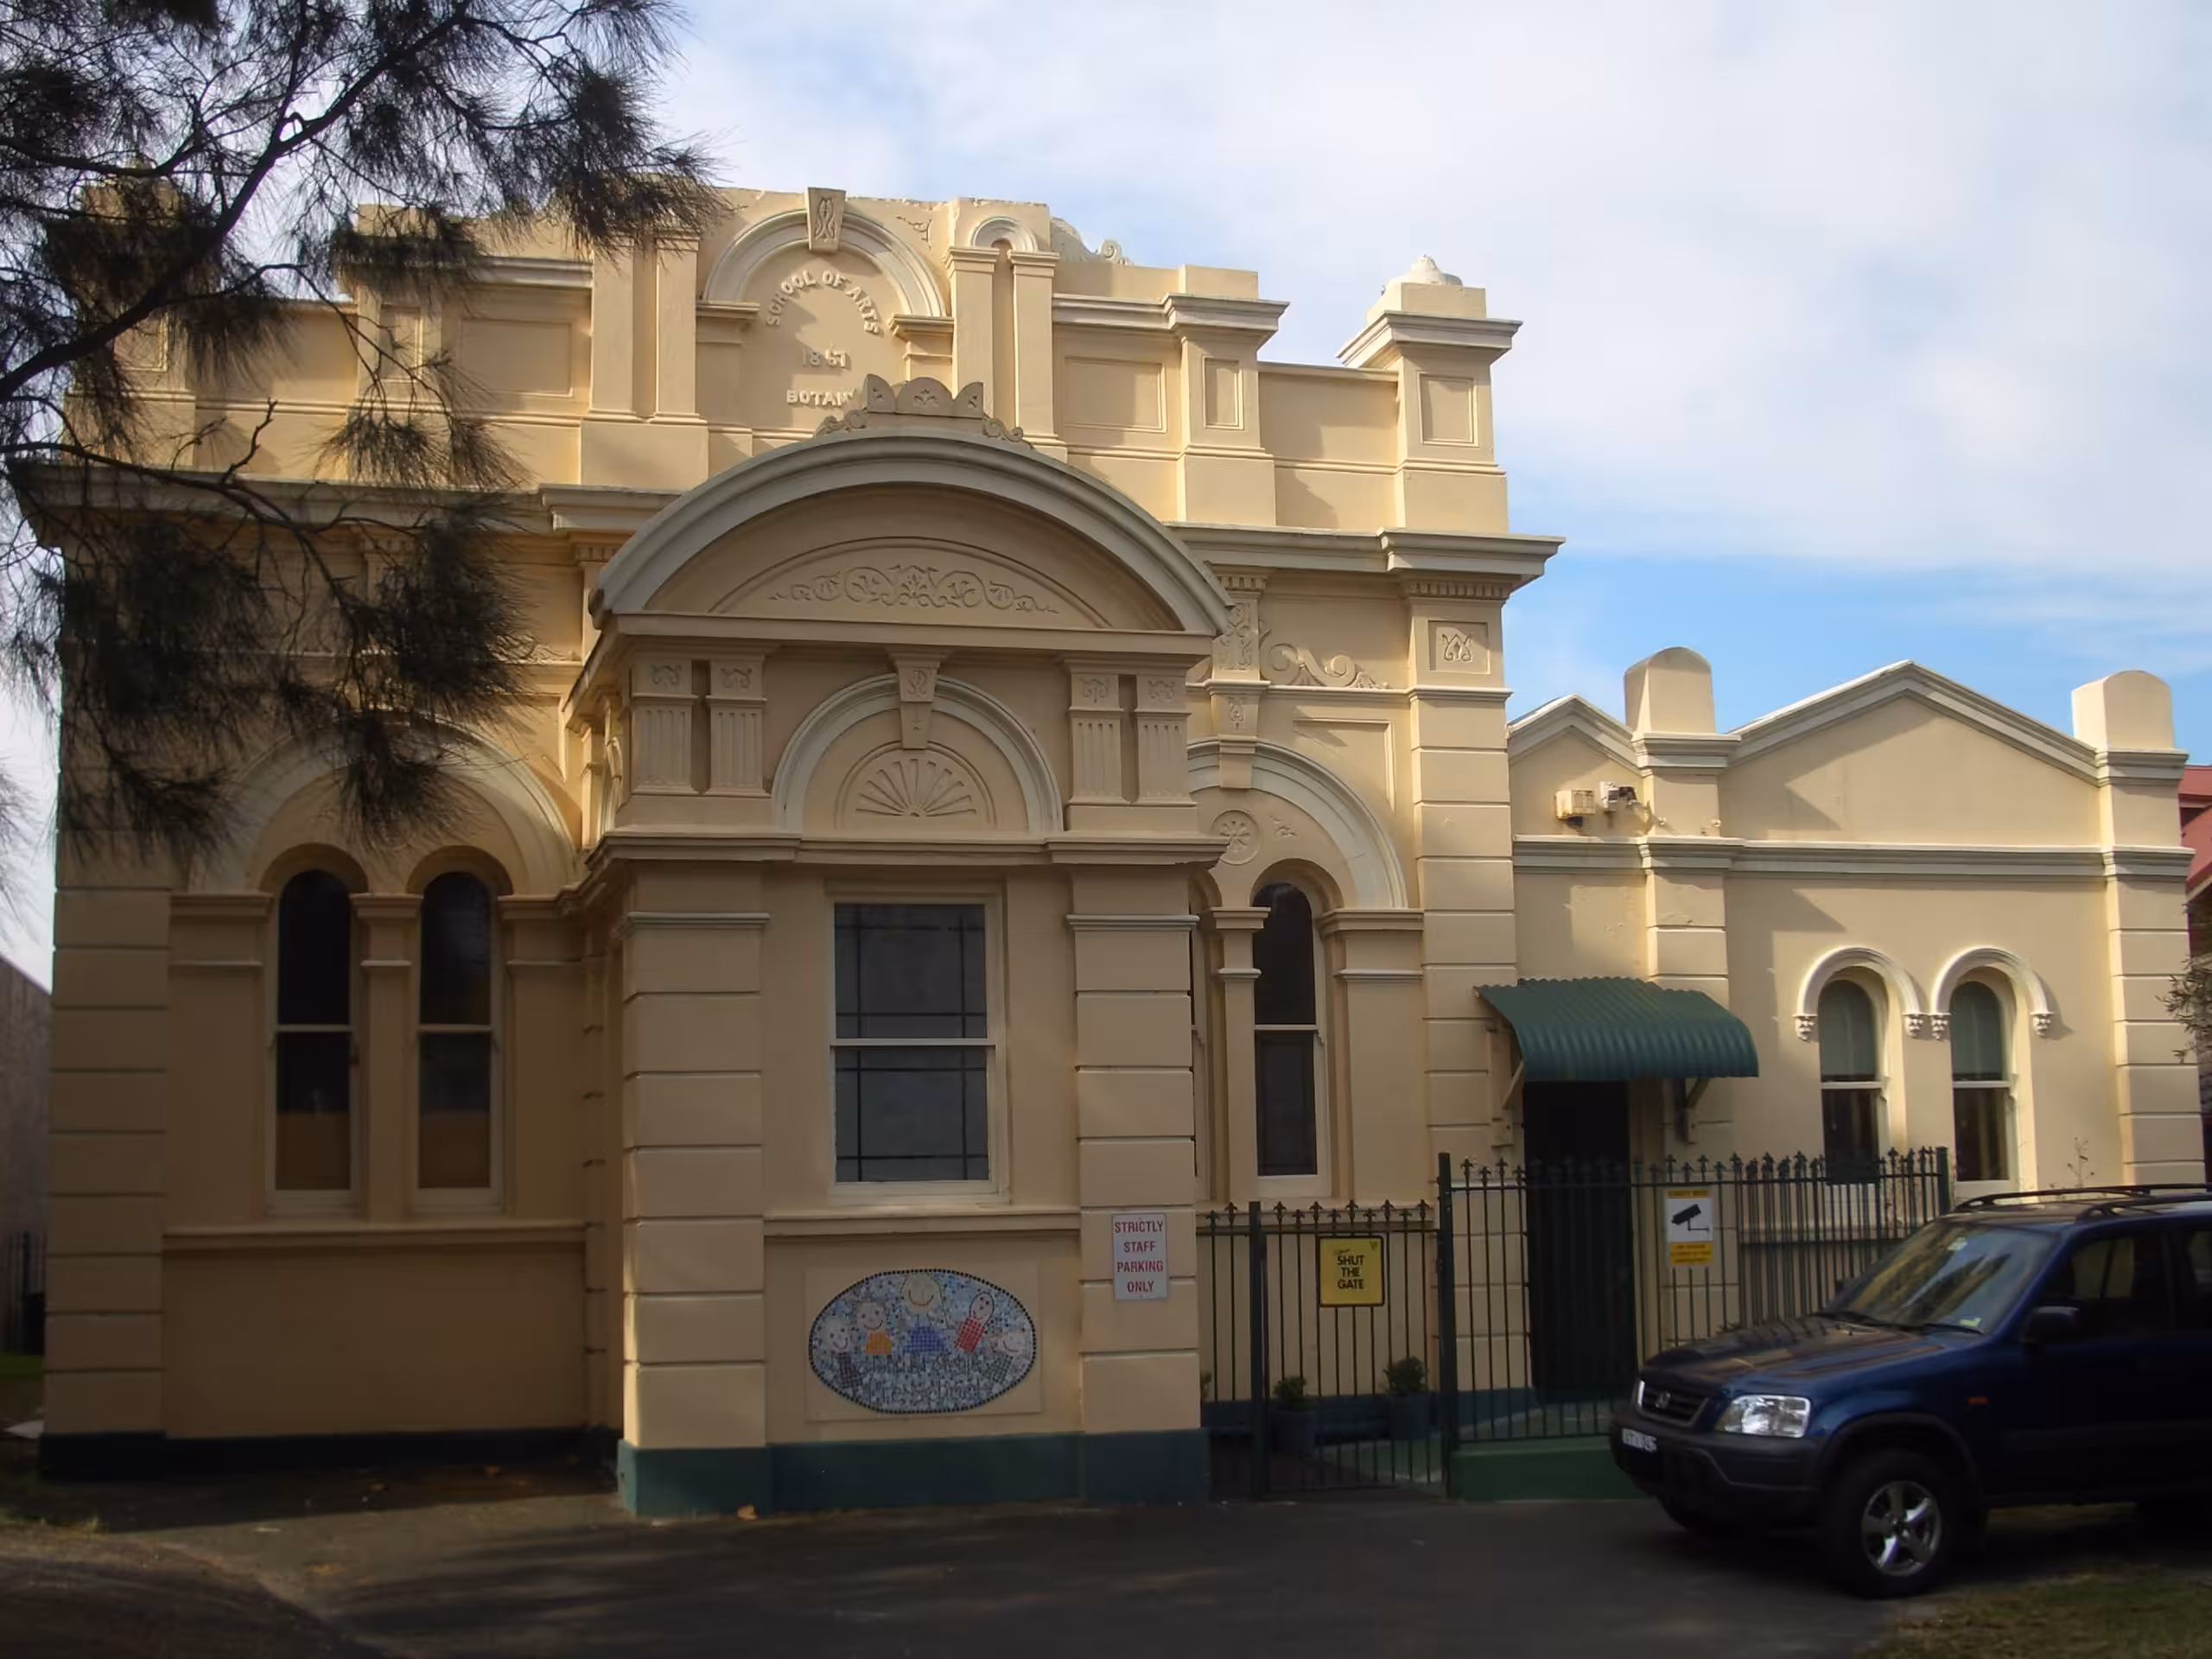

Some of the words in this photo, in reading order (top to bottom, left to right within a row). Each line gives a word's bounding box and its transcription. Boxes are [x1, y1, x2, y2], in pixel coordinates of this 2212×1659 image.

[766, 270, 817, 326] SCHOOL
[822, 270, 847, 288] OF
[845, 286, 880, 335] ARTS
[1114, 1221, 1164, 1233] STRICTLY
[1123, 1241, 1156, 1253] STAFF
[1337, 1255, 1364, 1266] SHUT
[1116, 1261, 1164, 1273] PARKING
[1341, 1267, 1361, 1277] THE
[1127, 1281, 1154, 1294] ONLY
[1337, 1279, 1365, 1289] GATE
